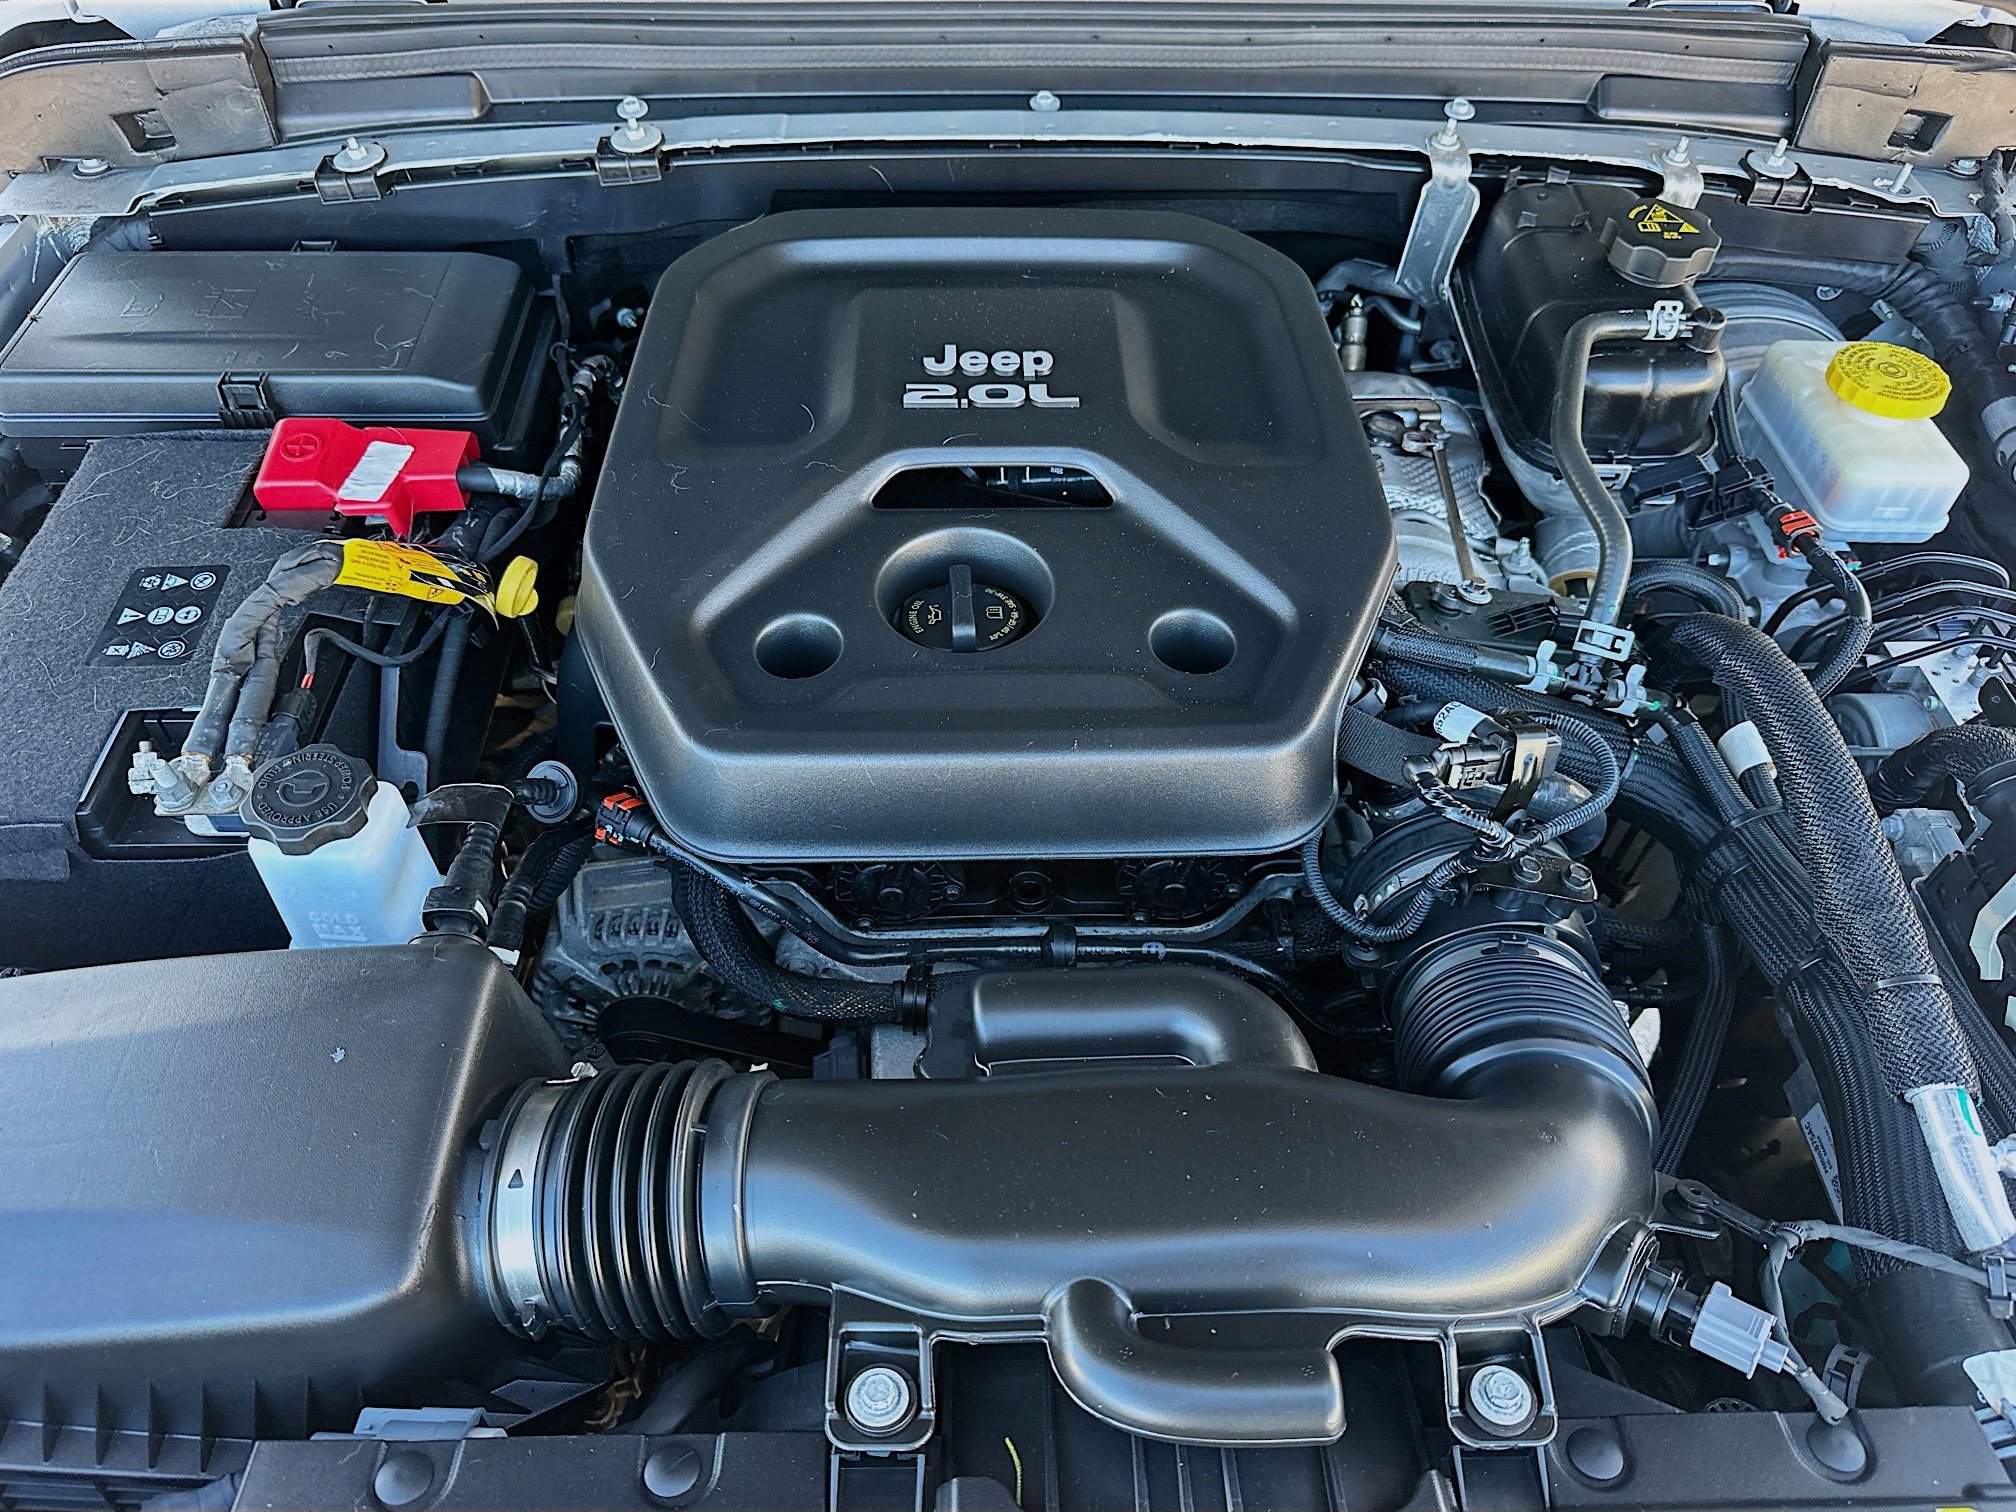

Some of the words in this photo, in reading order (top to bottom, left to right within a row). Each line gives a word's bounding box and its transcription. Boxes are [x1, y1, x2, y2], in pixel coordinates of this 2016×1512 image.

[922, 344, 1054, 381] Jeep
[903, 383, 1080, 409] 2.0L
[911, 600, 925, 610] OIL
[908, 610, 925, 634] ENGINE
[282, 752, 337, 768] STEERING
[258, 765, 282, 789] FLUID
[334, 761, 352, 792] POWER
[257, 802, 312, 825] APPROVED
[315, 802, 338, 818] USE
[311, 923, 365, 937] MAX
